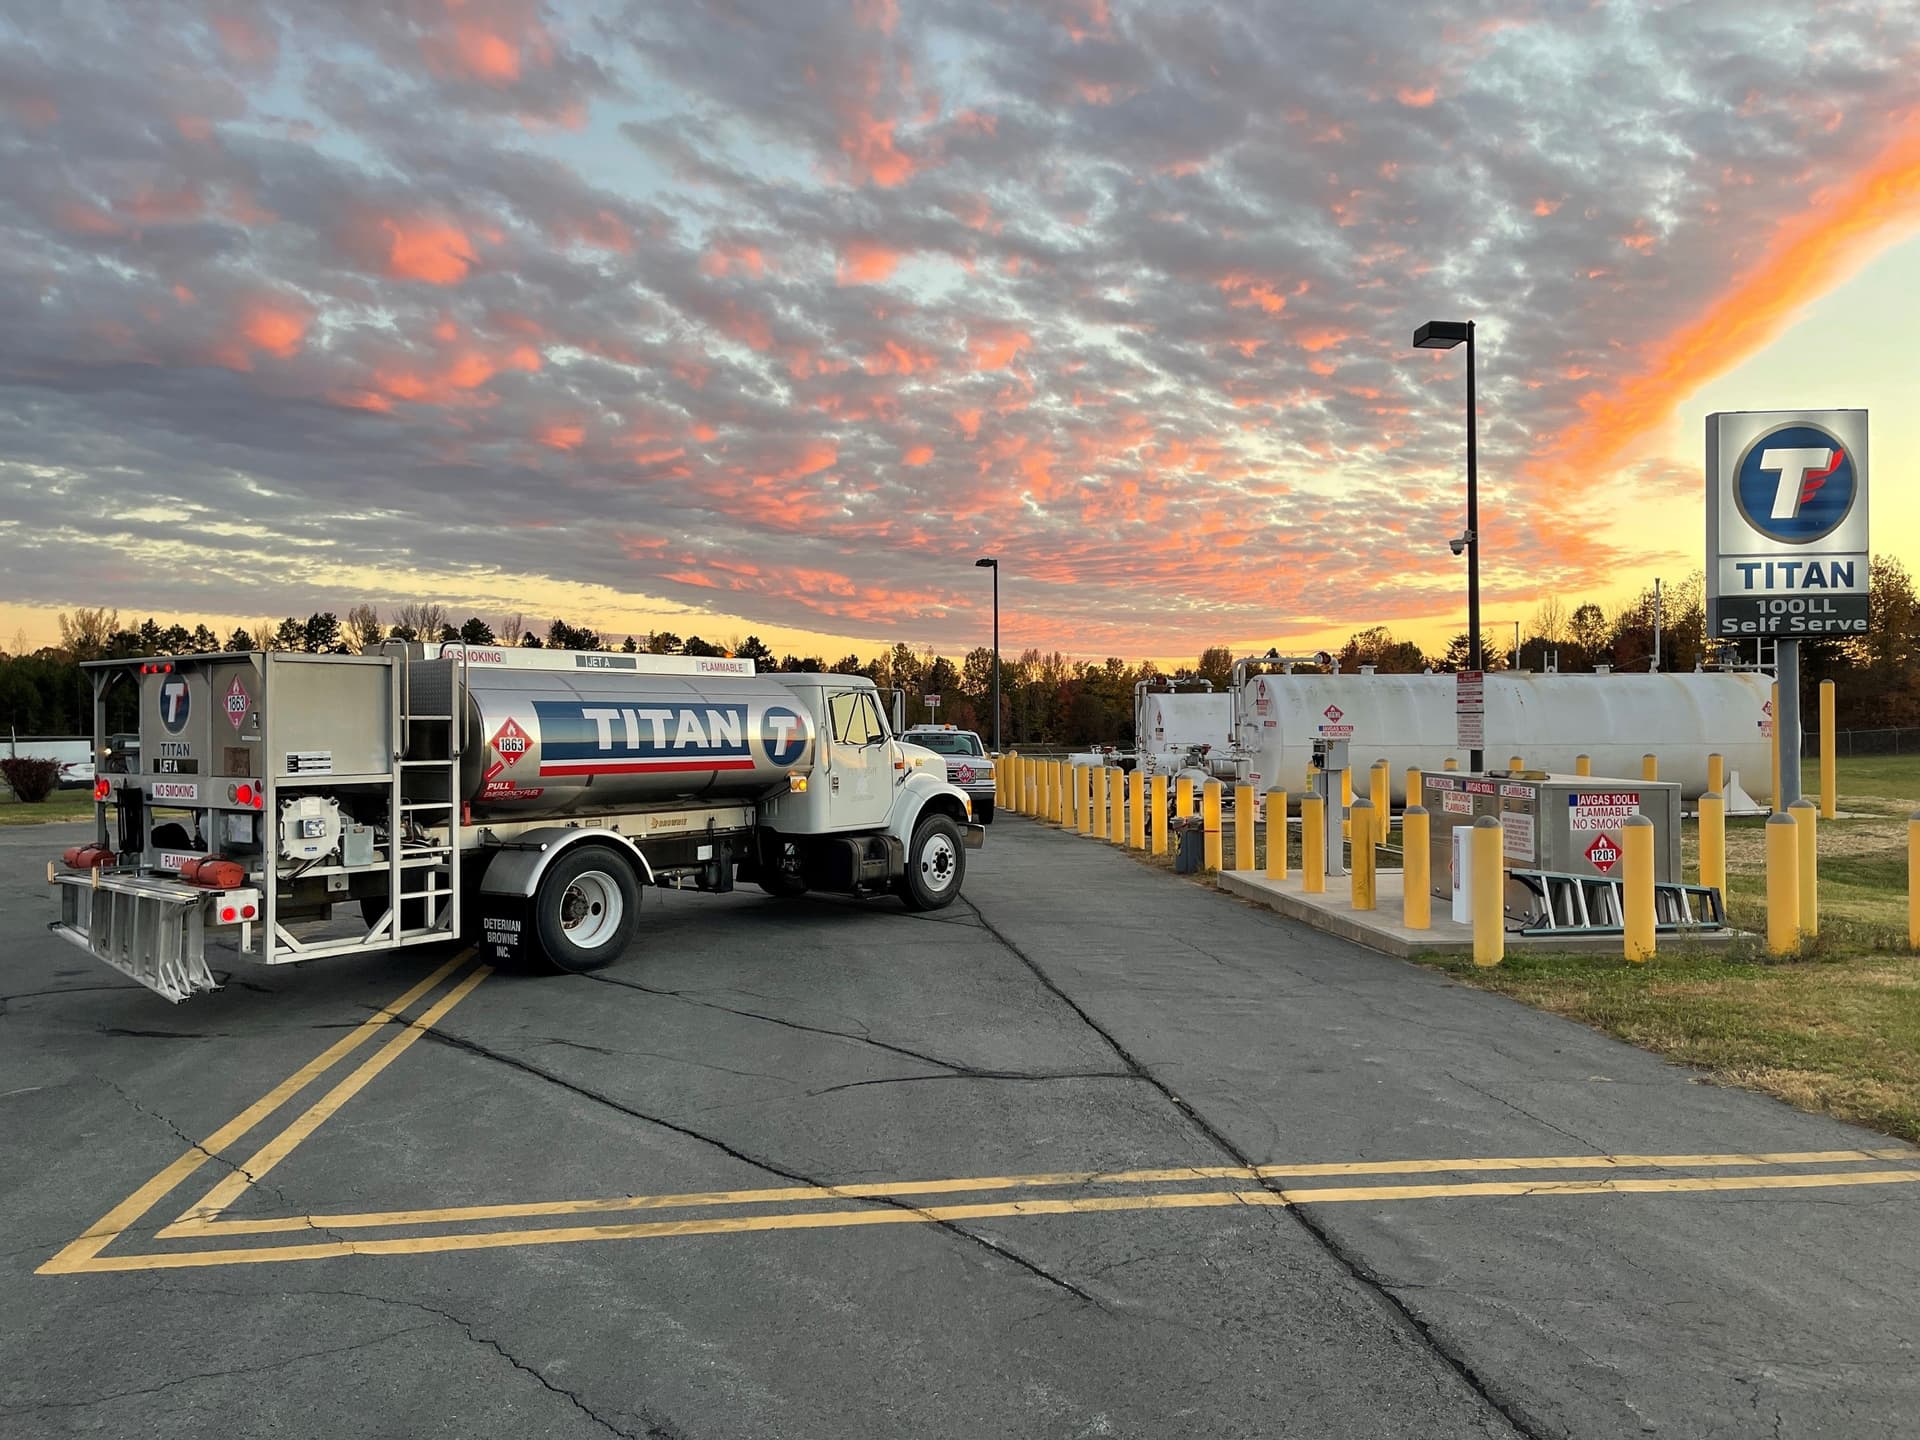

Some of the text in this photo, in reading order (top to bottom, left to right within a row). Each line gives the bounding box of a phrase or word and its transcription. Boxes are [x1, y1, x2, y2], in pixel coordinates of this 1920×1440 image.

[1760, 448, 1834, 519] T
[1736, 561, 1854, 590] TITAN
[1756, 599, 1837, 614] 100LL
[1722, 616, 1867, 633] Self Serve
[457, 650, 501, 662] SMOKING
[588, 657, 610, 668] JET A
[701, 662, 744, 673] FLAMMABLE
[165, 683, 184, 722] T
[229, 696, 245, 711] 1863
[582, 708, 742, 750] TITAN
[769, 716, 797, 756] T
[161, 743, 190, 757] TITAN
[500, 739, 523, 751] 1863
[162, 760, 178, 773] JET A
[155, 784, 194, 797] NO SMOKING
[1503, 786, 1533, 797] FLAMMABLE
[1580, 794, 1638, 805] AVGAS 100LL
[1445, 802, 1470, 813] FLAMMABLE
[1576, 806, 1632, 817] FLAMMABLE
[1572, 818, 1626, 829] NO SMOKI
[1593, 849, 1614, 861] 1203
[483, 918, 521, 931] DETERMAN
[487, 931, 518, 945] BROWNIE
[496, 945, 510, 958] INC.
